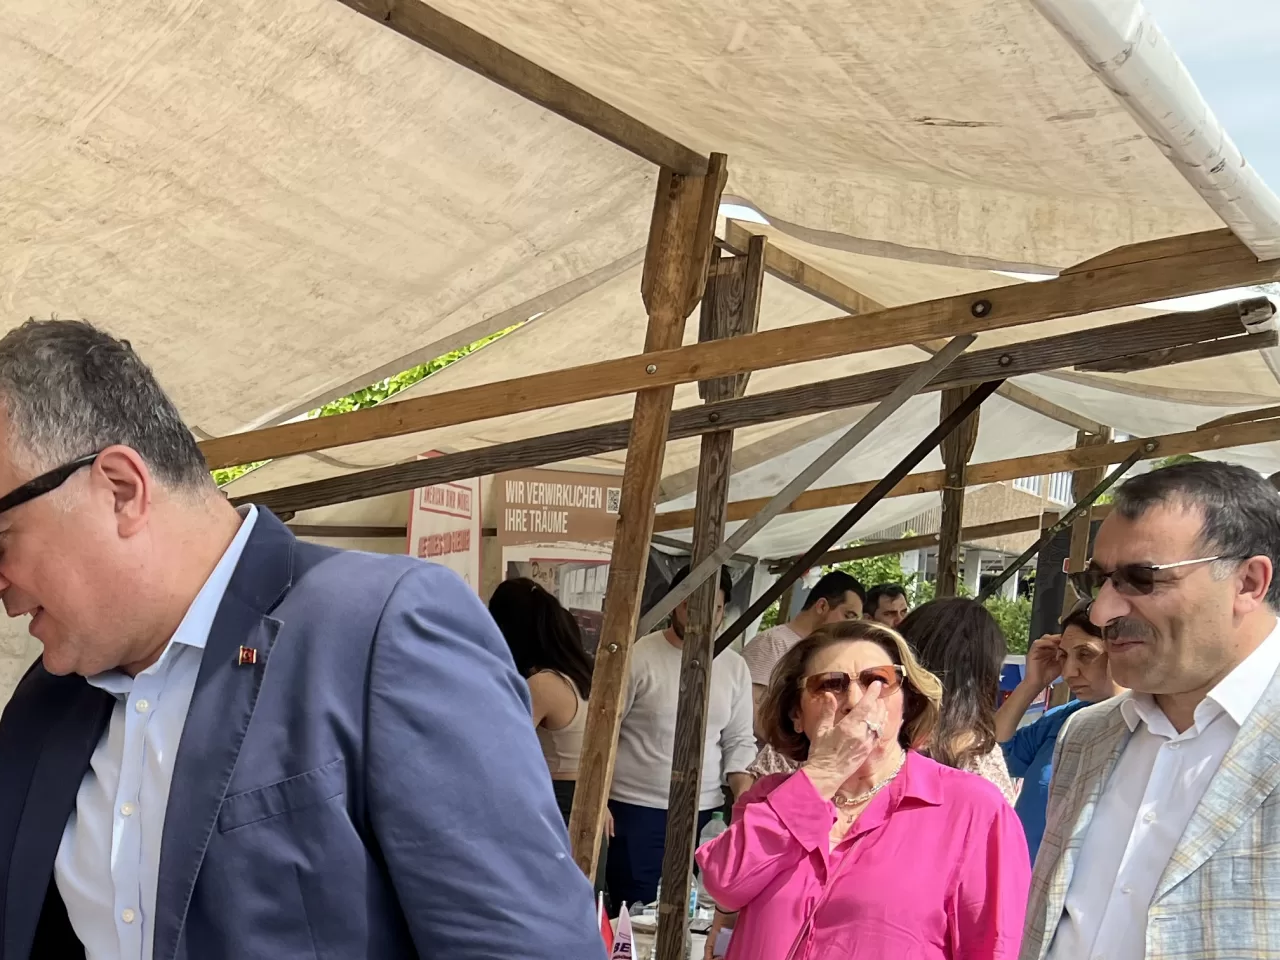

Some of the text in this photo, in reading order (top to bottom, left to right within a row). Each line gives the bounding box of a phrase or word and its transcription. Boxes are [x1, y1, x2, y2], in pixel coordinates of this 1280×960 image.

[505, 480, 603, 508] WIR VERWIRKLICHEN
[504, 506, 569, 534] IHRE TRÄUME
